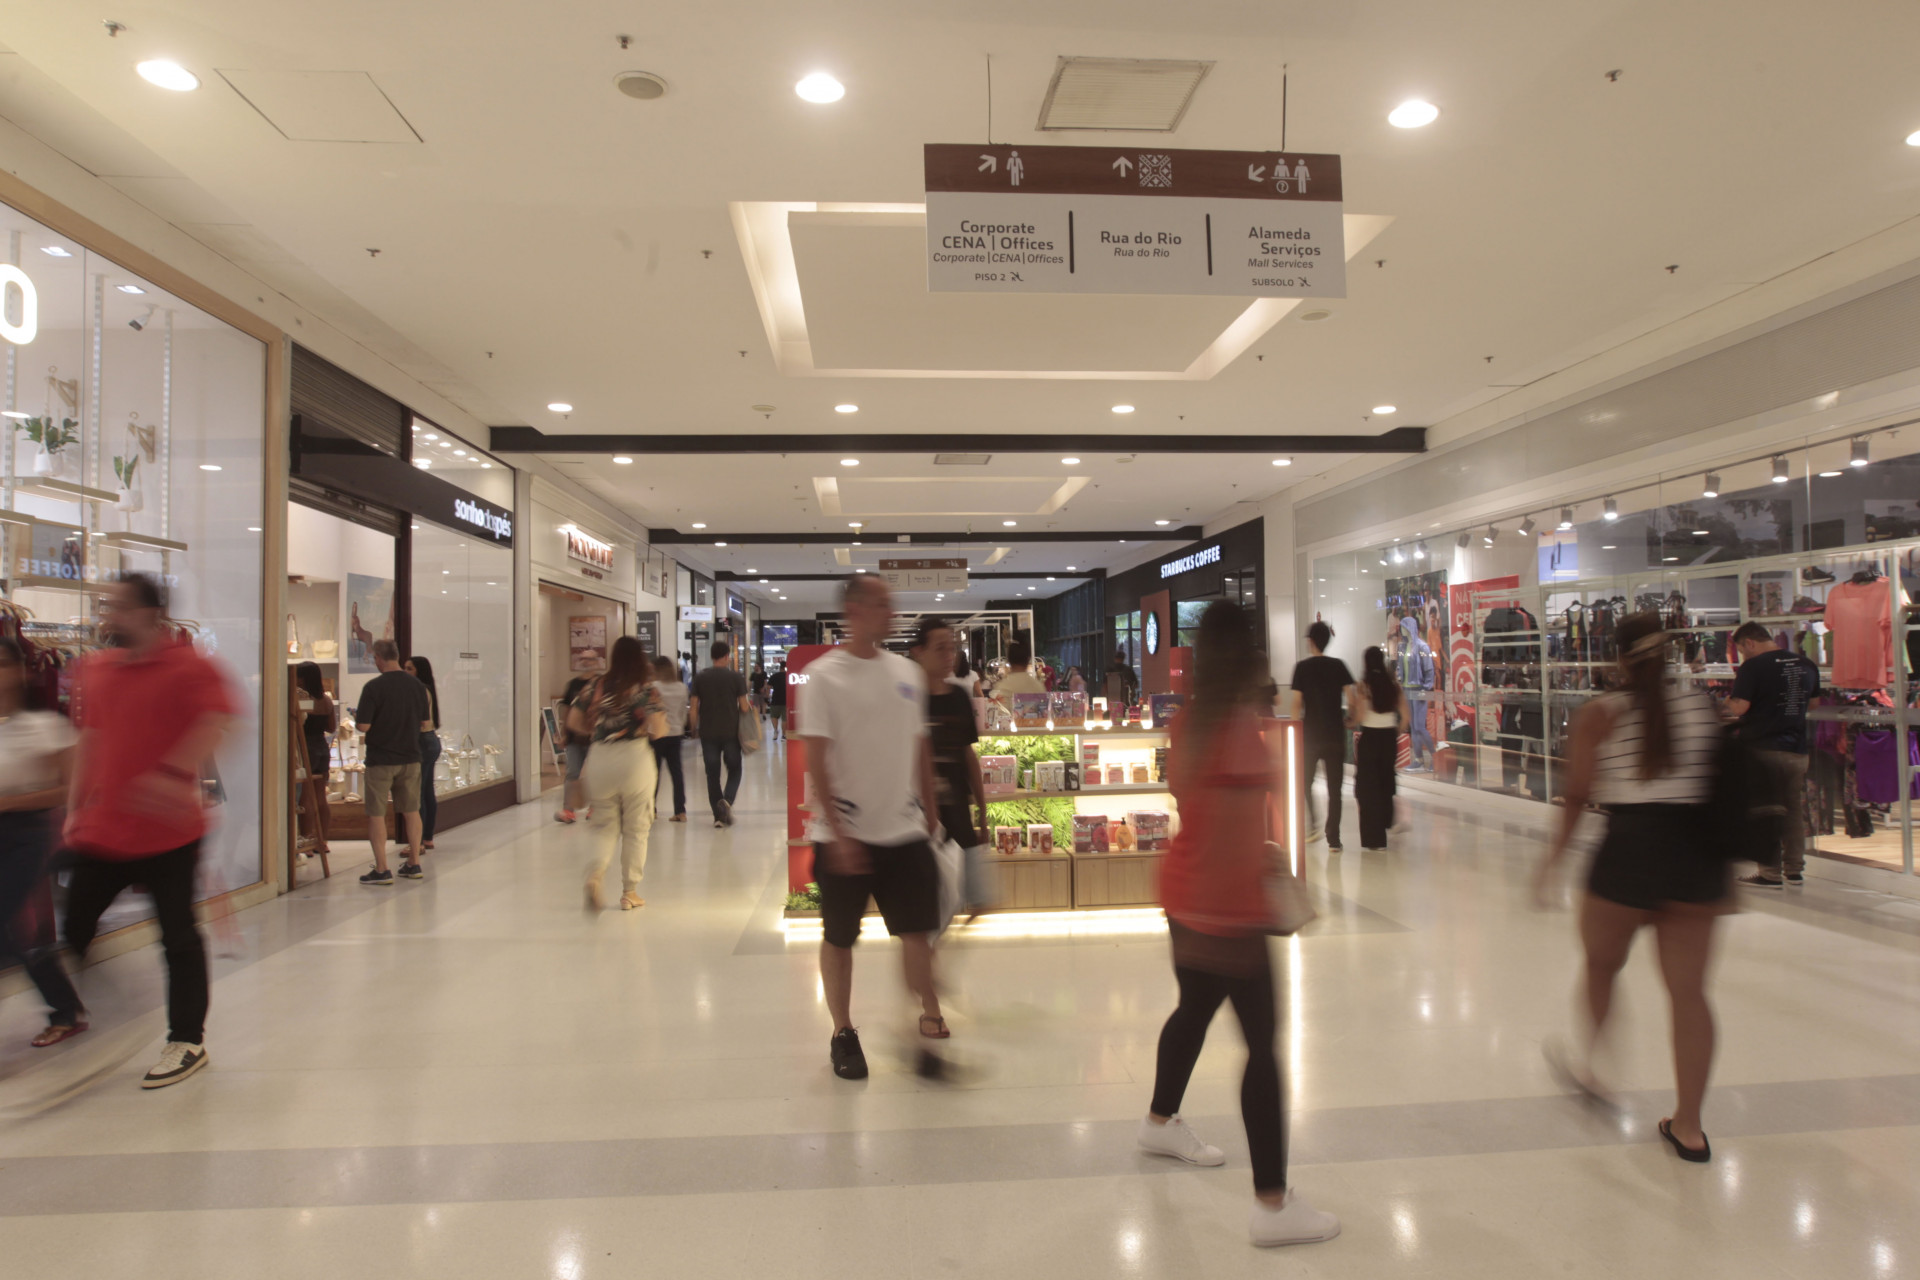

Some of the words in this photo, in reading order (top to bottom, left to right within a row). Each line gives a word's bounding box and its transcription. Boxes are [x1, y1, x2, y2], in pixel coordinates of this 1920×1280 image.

[961, 220, 1035, 236] Corporate
[1248, 226, 1311, 241] Alameda
[942, 236, 986, 249] CENA
[1000, 237, 1054, 251] Offices
[1100, 231, 1129, 244] Rua
[1134, 231, 1152, 245] do
[1157, 232, 1182, 245] Rio
[1113, 248, 1134, 257] Rua
[1137, 248, 1150, 257] do
[1153, 248, 1170, 258] Rio
[1261, 242, 1321, 259] Serviços
[1248, 258, 1269, 268] Mall
[1271, 259, 1314, 269] Services
[975, 273, 997, 281] PISO
[1000, 273, 1006, 281] 2
[1252, 278, 1294, 287] SUBSOLO
[1160, 554, 1195, 579] STARBUCKS
[1194, 544, 1221, 568] COFFEE
